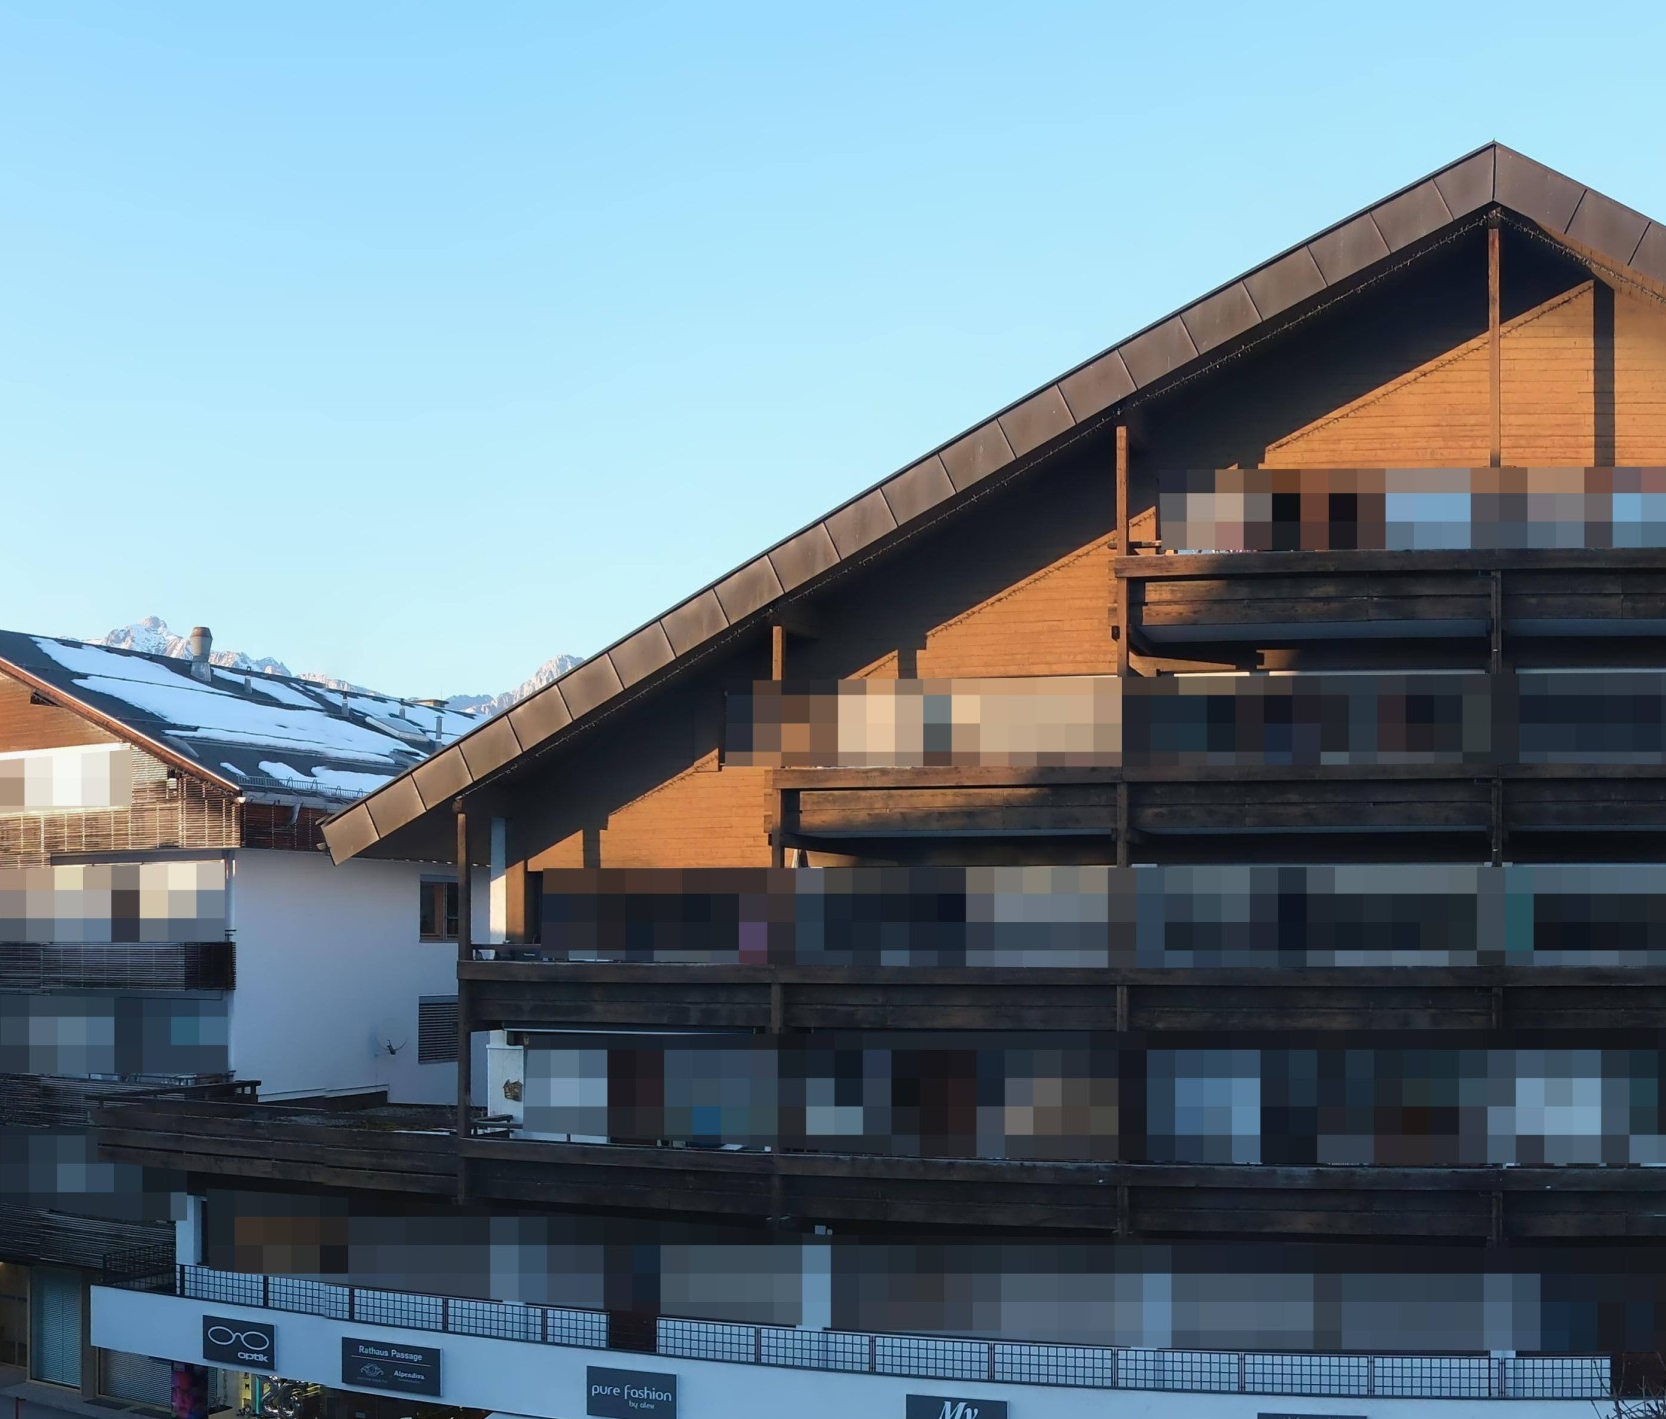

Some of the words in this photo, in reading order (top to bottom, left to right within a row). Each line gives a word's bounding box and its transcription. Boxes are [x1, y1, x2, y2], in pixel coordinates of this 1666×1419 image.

[237, 1351, 269, 1363] optik
[358, 1345, 389, 1357] Rathaus
[391, 1349, 423, 1362] Passage
[591, 1384, 621, 1397] pure
[624, 1384, 672, 1402] fashion
